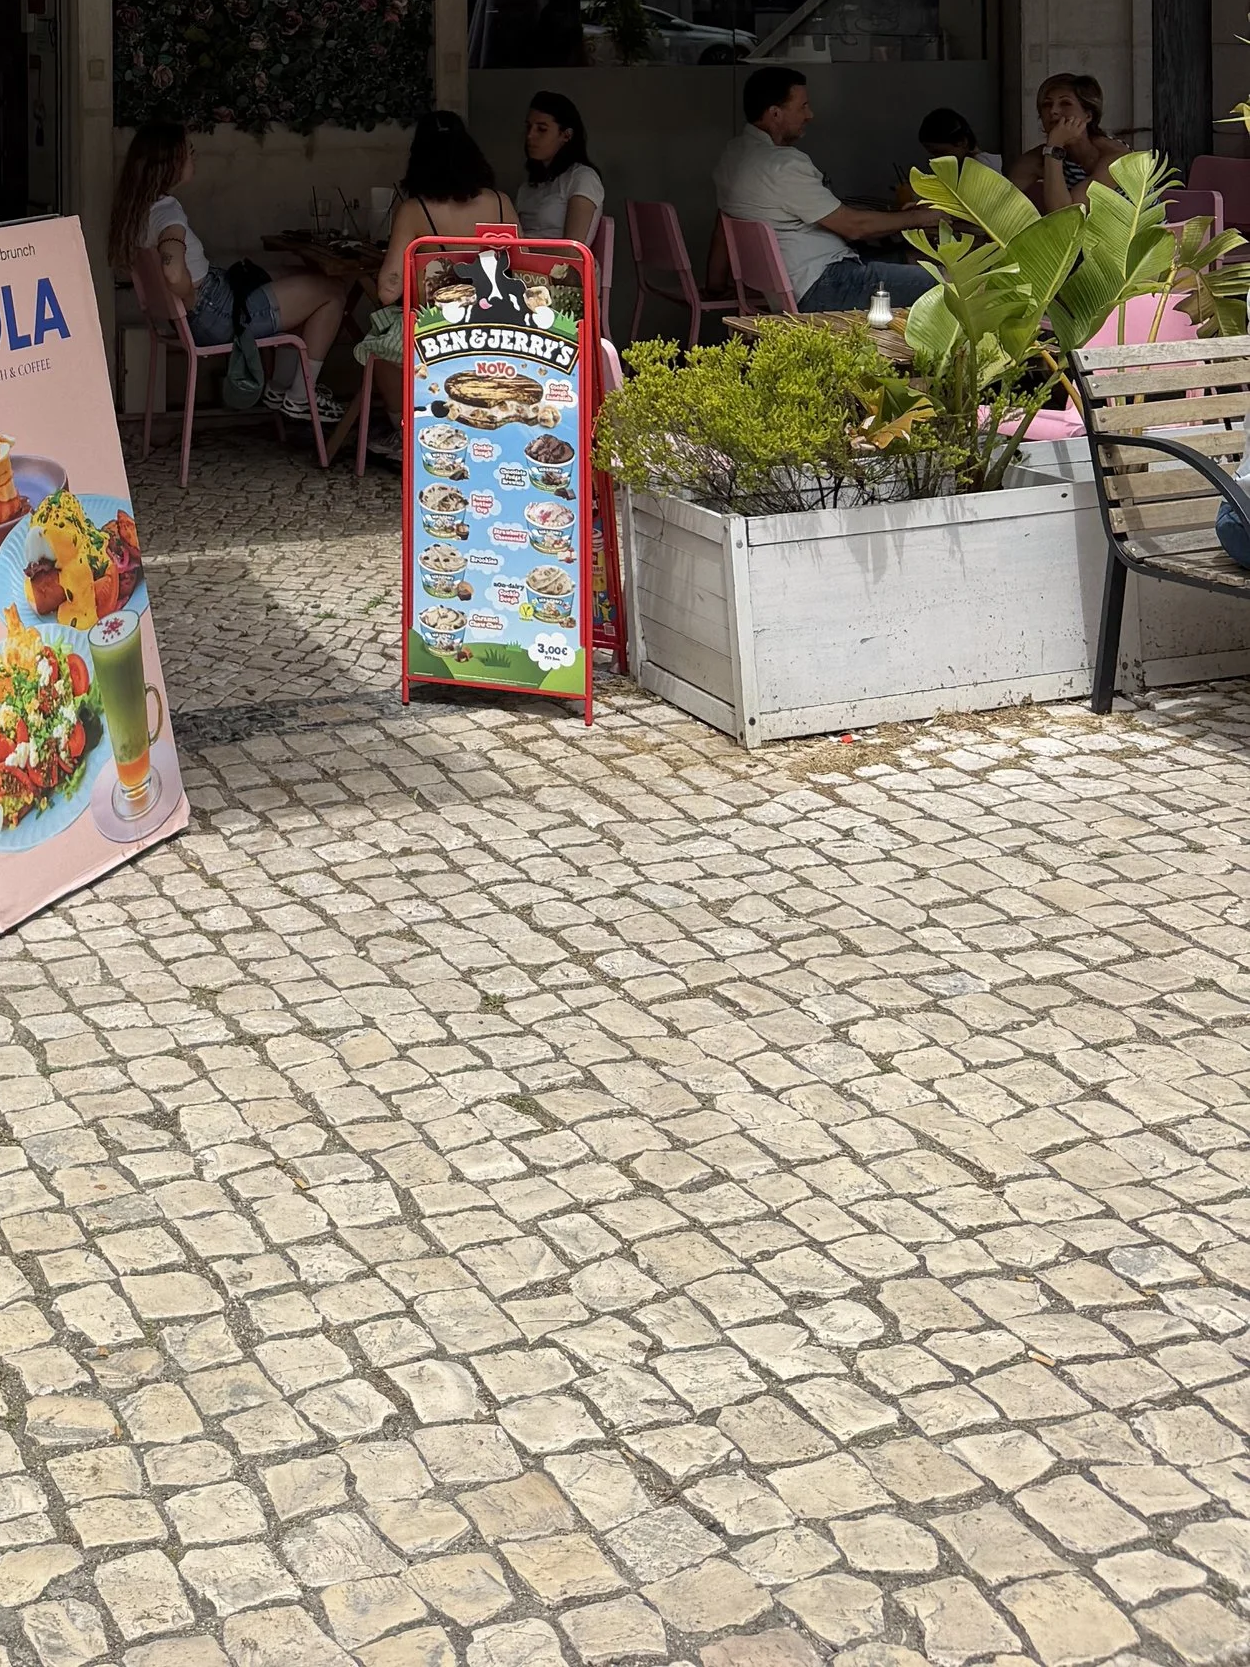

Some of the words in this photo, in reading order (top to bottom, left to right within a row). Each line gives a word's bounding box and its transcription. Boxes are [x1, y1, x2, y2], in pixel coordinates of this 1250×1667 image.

[9, 367, 17, 379] &
[17, 357, 52, 377] COFFEE
[477, 362, 516, 378] NOVO
[537, 643, 568, 655] 3,00€
